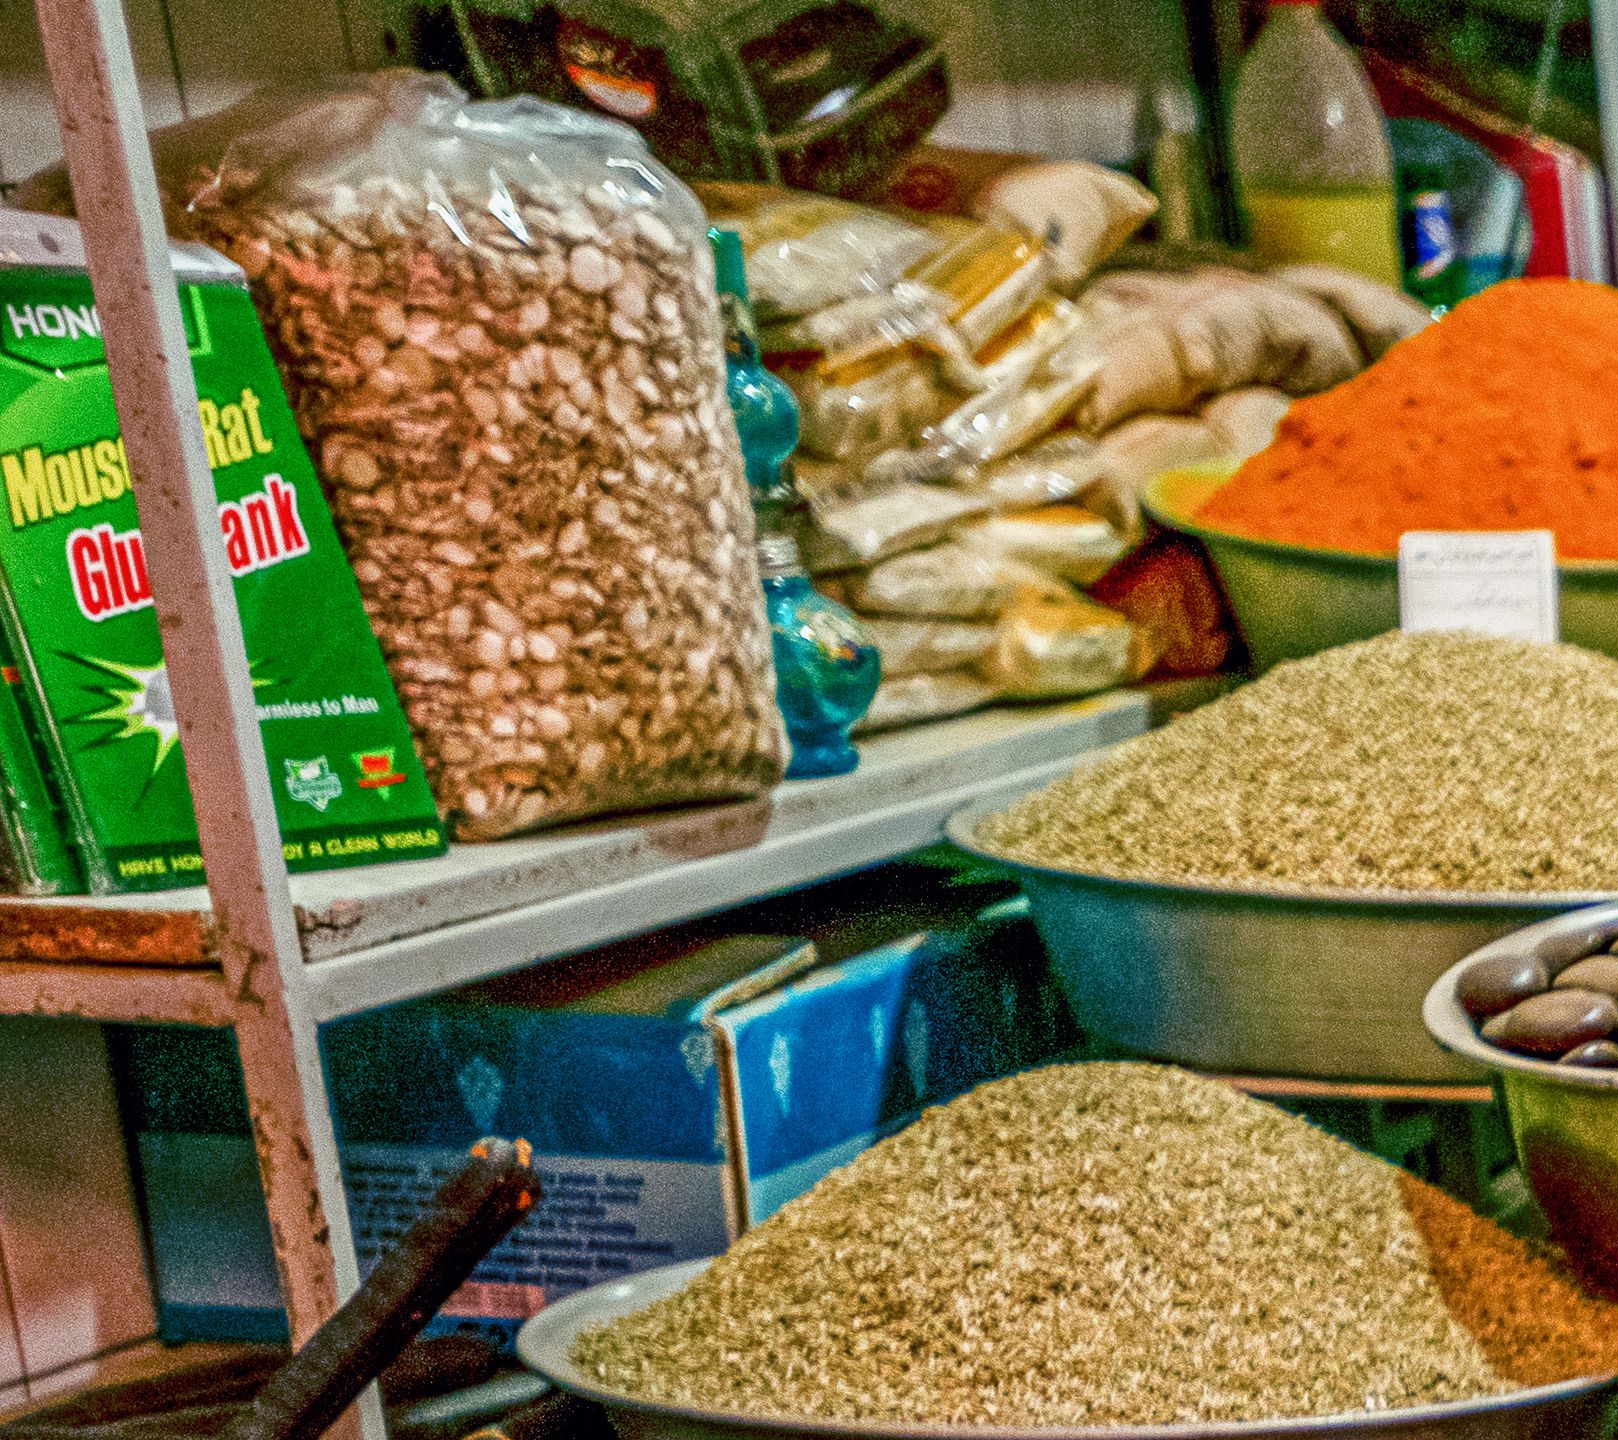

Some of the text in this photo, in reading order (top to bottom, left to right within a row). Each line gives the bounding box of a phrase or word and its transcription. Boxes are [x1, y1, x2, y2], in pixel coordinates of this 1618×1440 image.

[5, 303, 103, 340] HON
[198, 388, 273, 470] Rat
[67, 474, 310, 621] Glu ank
